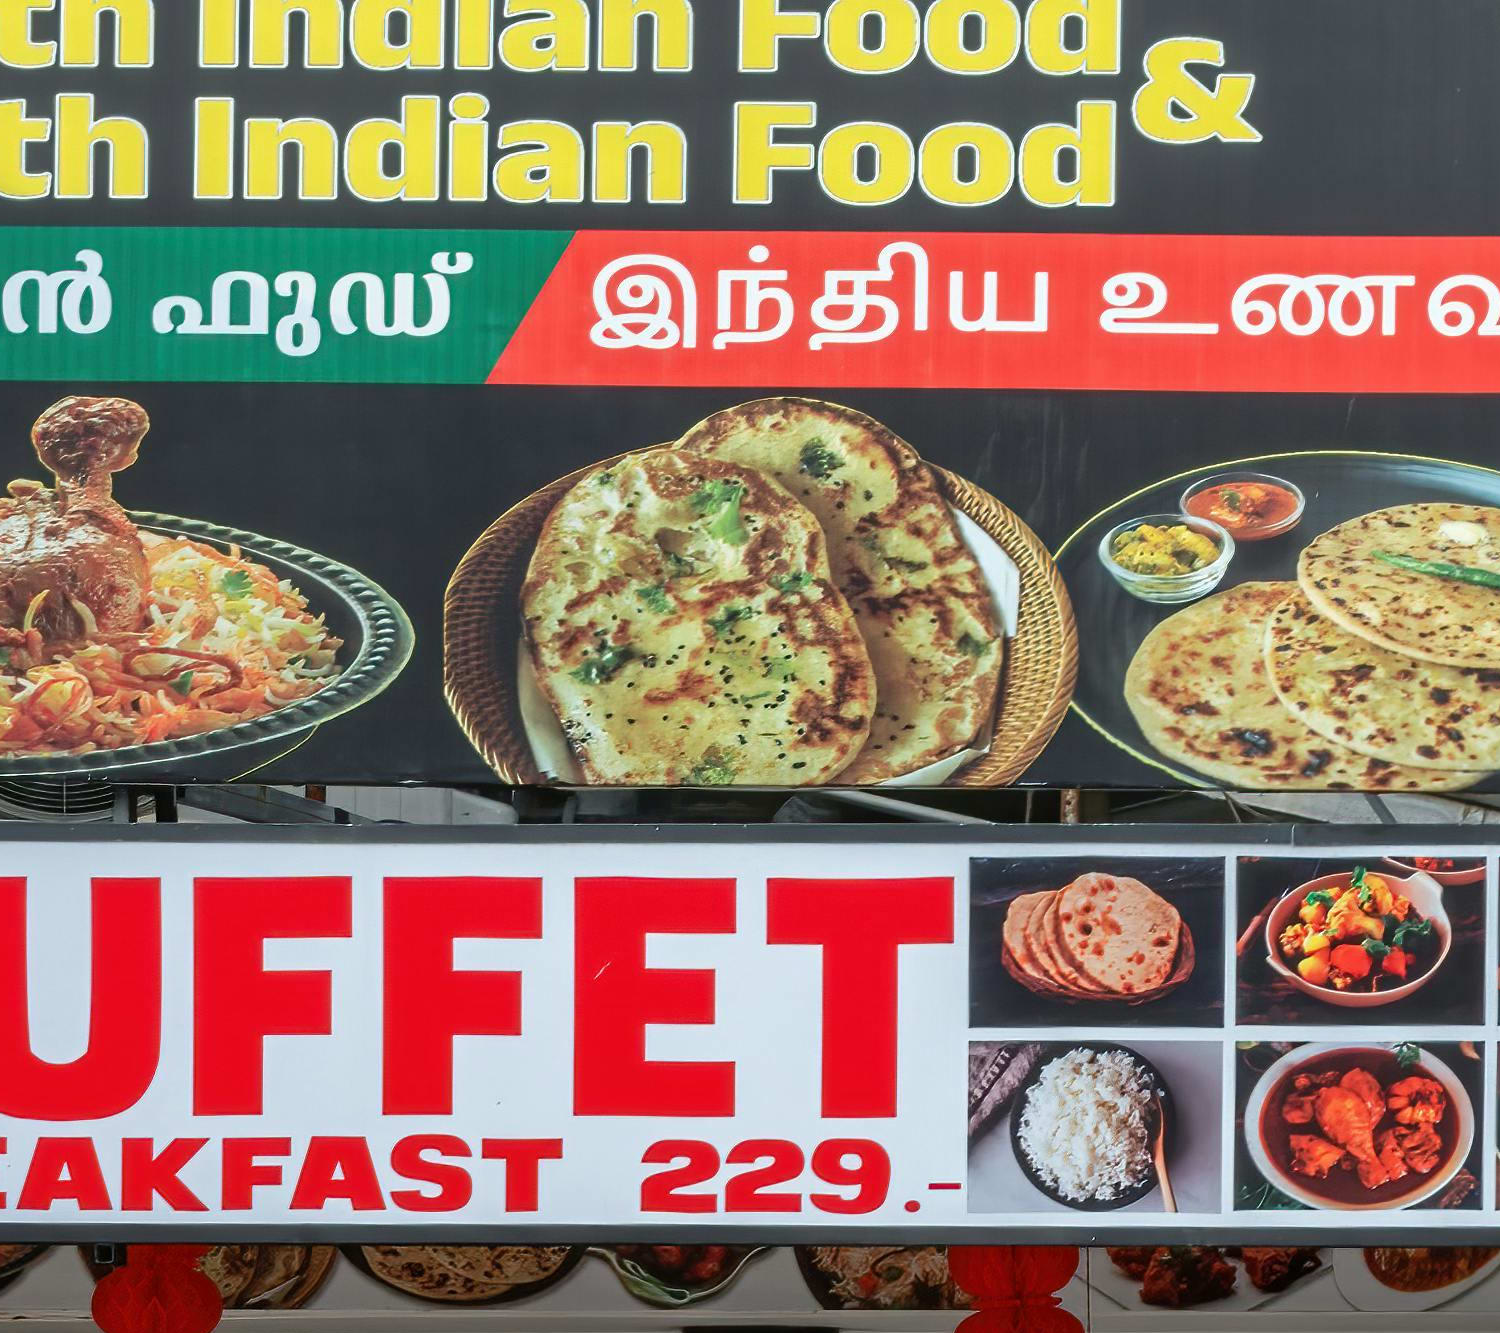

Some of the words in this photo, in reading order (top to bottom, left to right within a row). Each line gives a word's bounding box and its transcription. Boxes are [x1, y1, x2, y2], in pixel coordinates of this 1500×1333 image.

[199, 0, 692, 71] Indian
[738, 0, 1120, 75] Food
[1133, 37, 1262, 143] &
[194, 92, 687, 203] Indian
[732, 100, 1117, 207] Food
[590, 242, 1050, 353] இந்திய
[641, 1139, 961, 1213] 229.-
